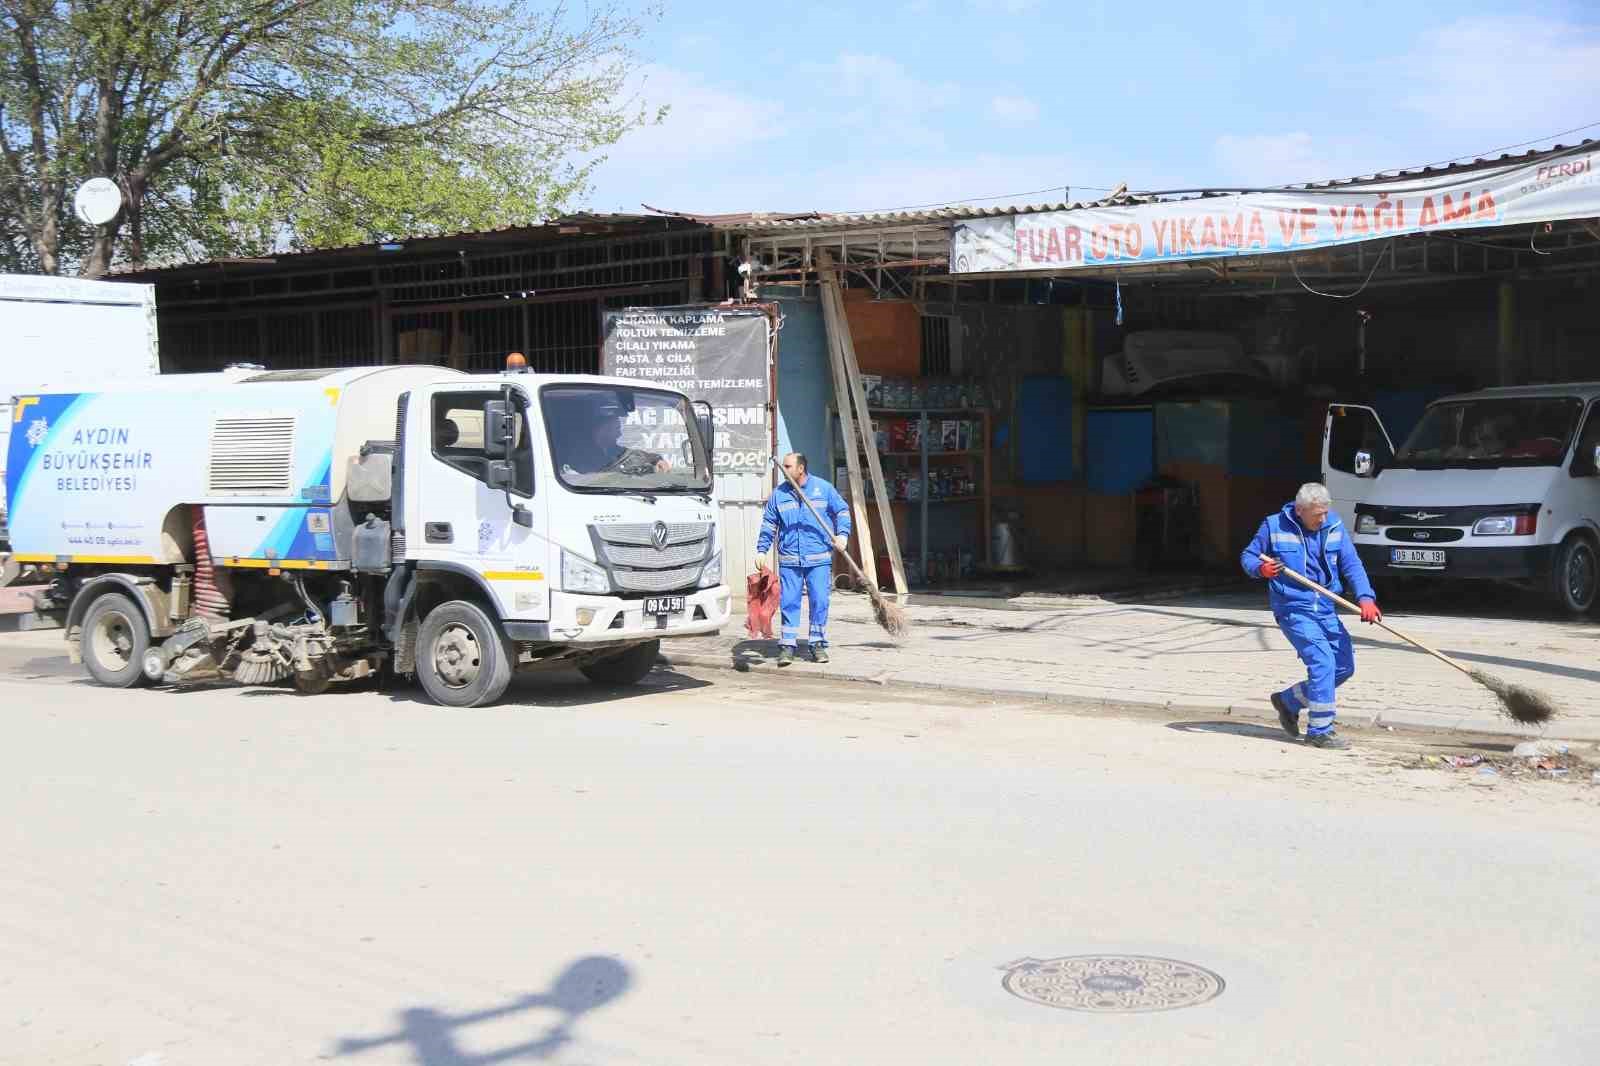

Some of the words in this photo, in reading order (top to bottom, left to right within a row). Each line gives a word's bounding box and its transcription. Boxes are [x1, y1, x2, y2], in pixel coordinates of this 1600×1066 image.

[1015, 225, 1083, 264] FUAR
[1091, 223, 1142, 259] OTO
[1152, 211, 1267, 256] YIKAMA
[1279, 208, 1318, 244] VE
[670, 314, 725, 325] KAPLAMA
[616, 327, 658, 337] KOLTUK
[661, 327, 726, 337] TEMİZLEME
[652, 340, 696, 350] YIKAMA
[616, 354, 650, 363] PASTA
[655, 354, 664, 363] &
[667, 352, 692, 363] CİLA
[616, 367, 636, 376] FAR
[698, 377, 764, 388] TEMİZLEME
[72, 428, 129, 445] AYDIN
[43, 449, 153, 474] BÜYÜKŞEHİR
[57, 476, 137, 490] BELEDİYESİ
